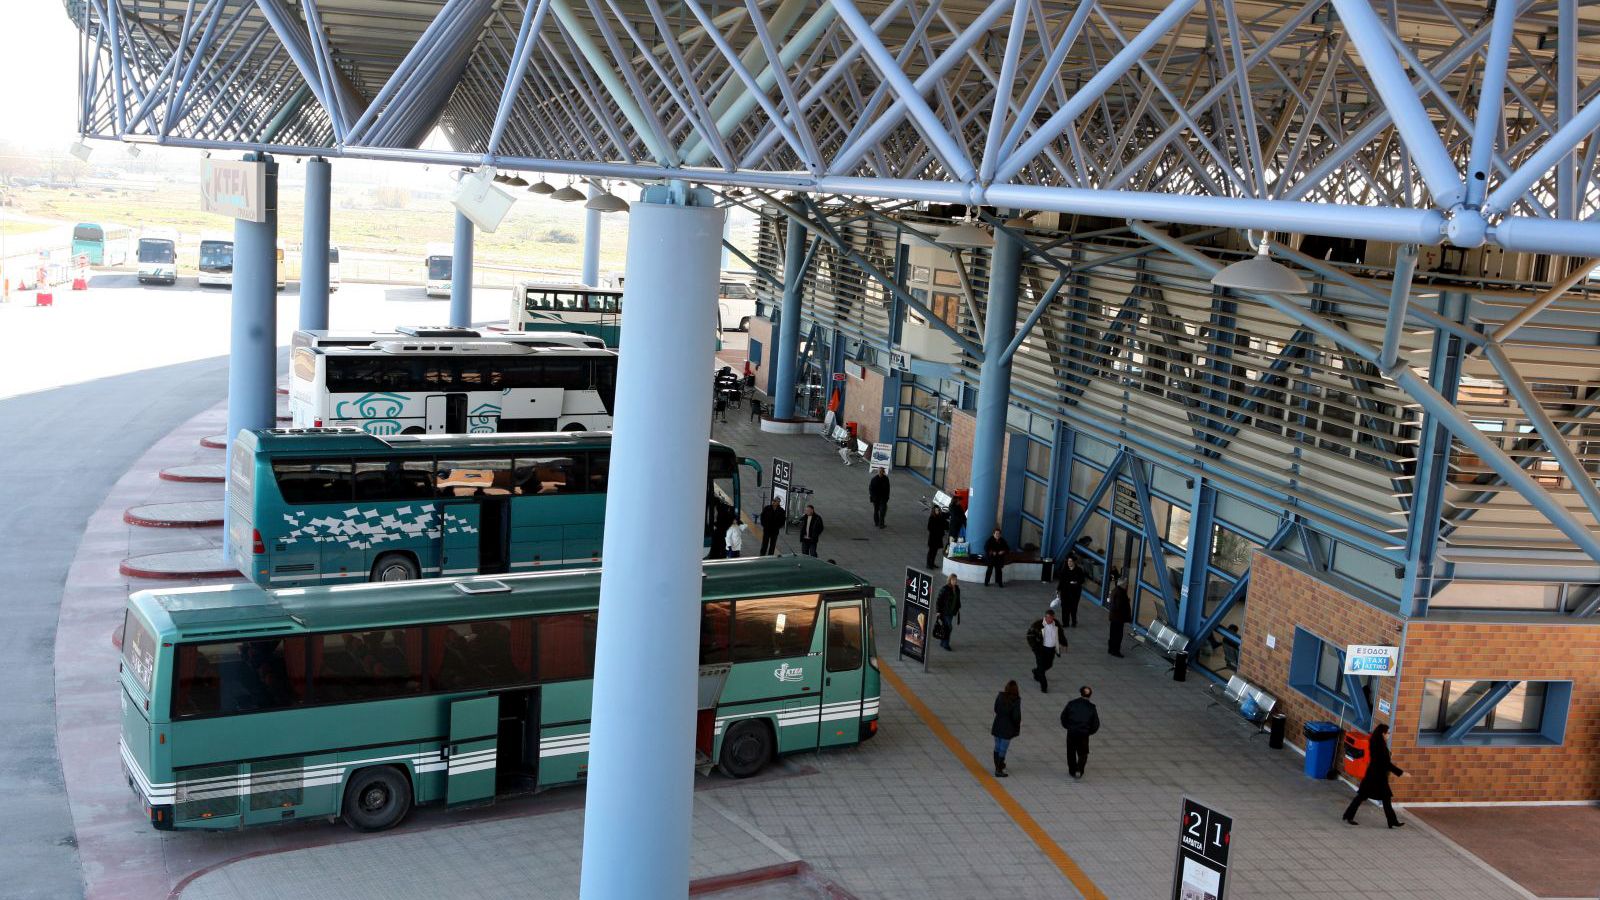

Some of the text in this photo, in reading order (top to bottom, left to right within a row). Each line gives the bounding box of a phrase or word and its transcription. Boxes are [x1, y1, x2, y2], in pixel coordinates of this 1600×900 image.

[775, 463, 789, 478] 6 5
[909, 576, 917, 592] 4
[921, 580, 929, 596] 3
[1188, 811, 1222, 847] 2 1
